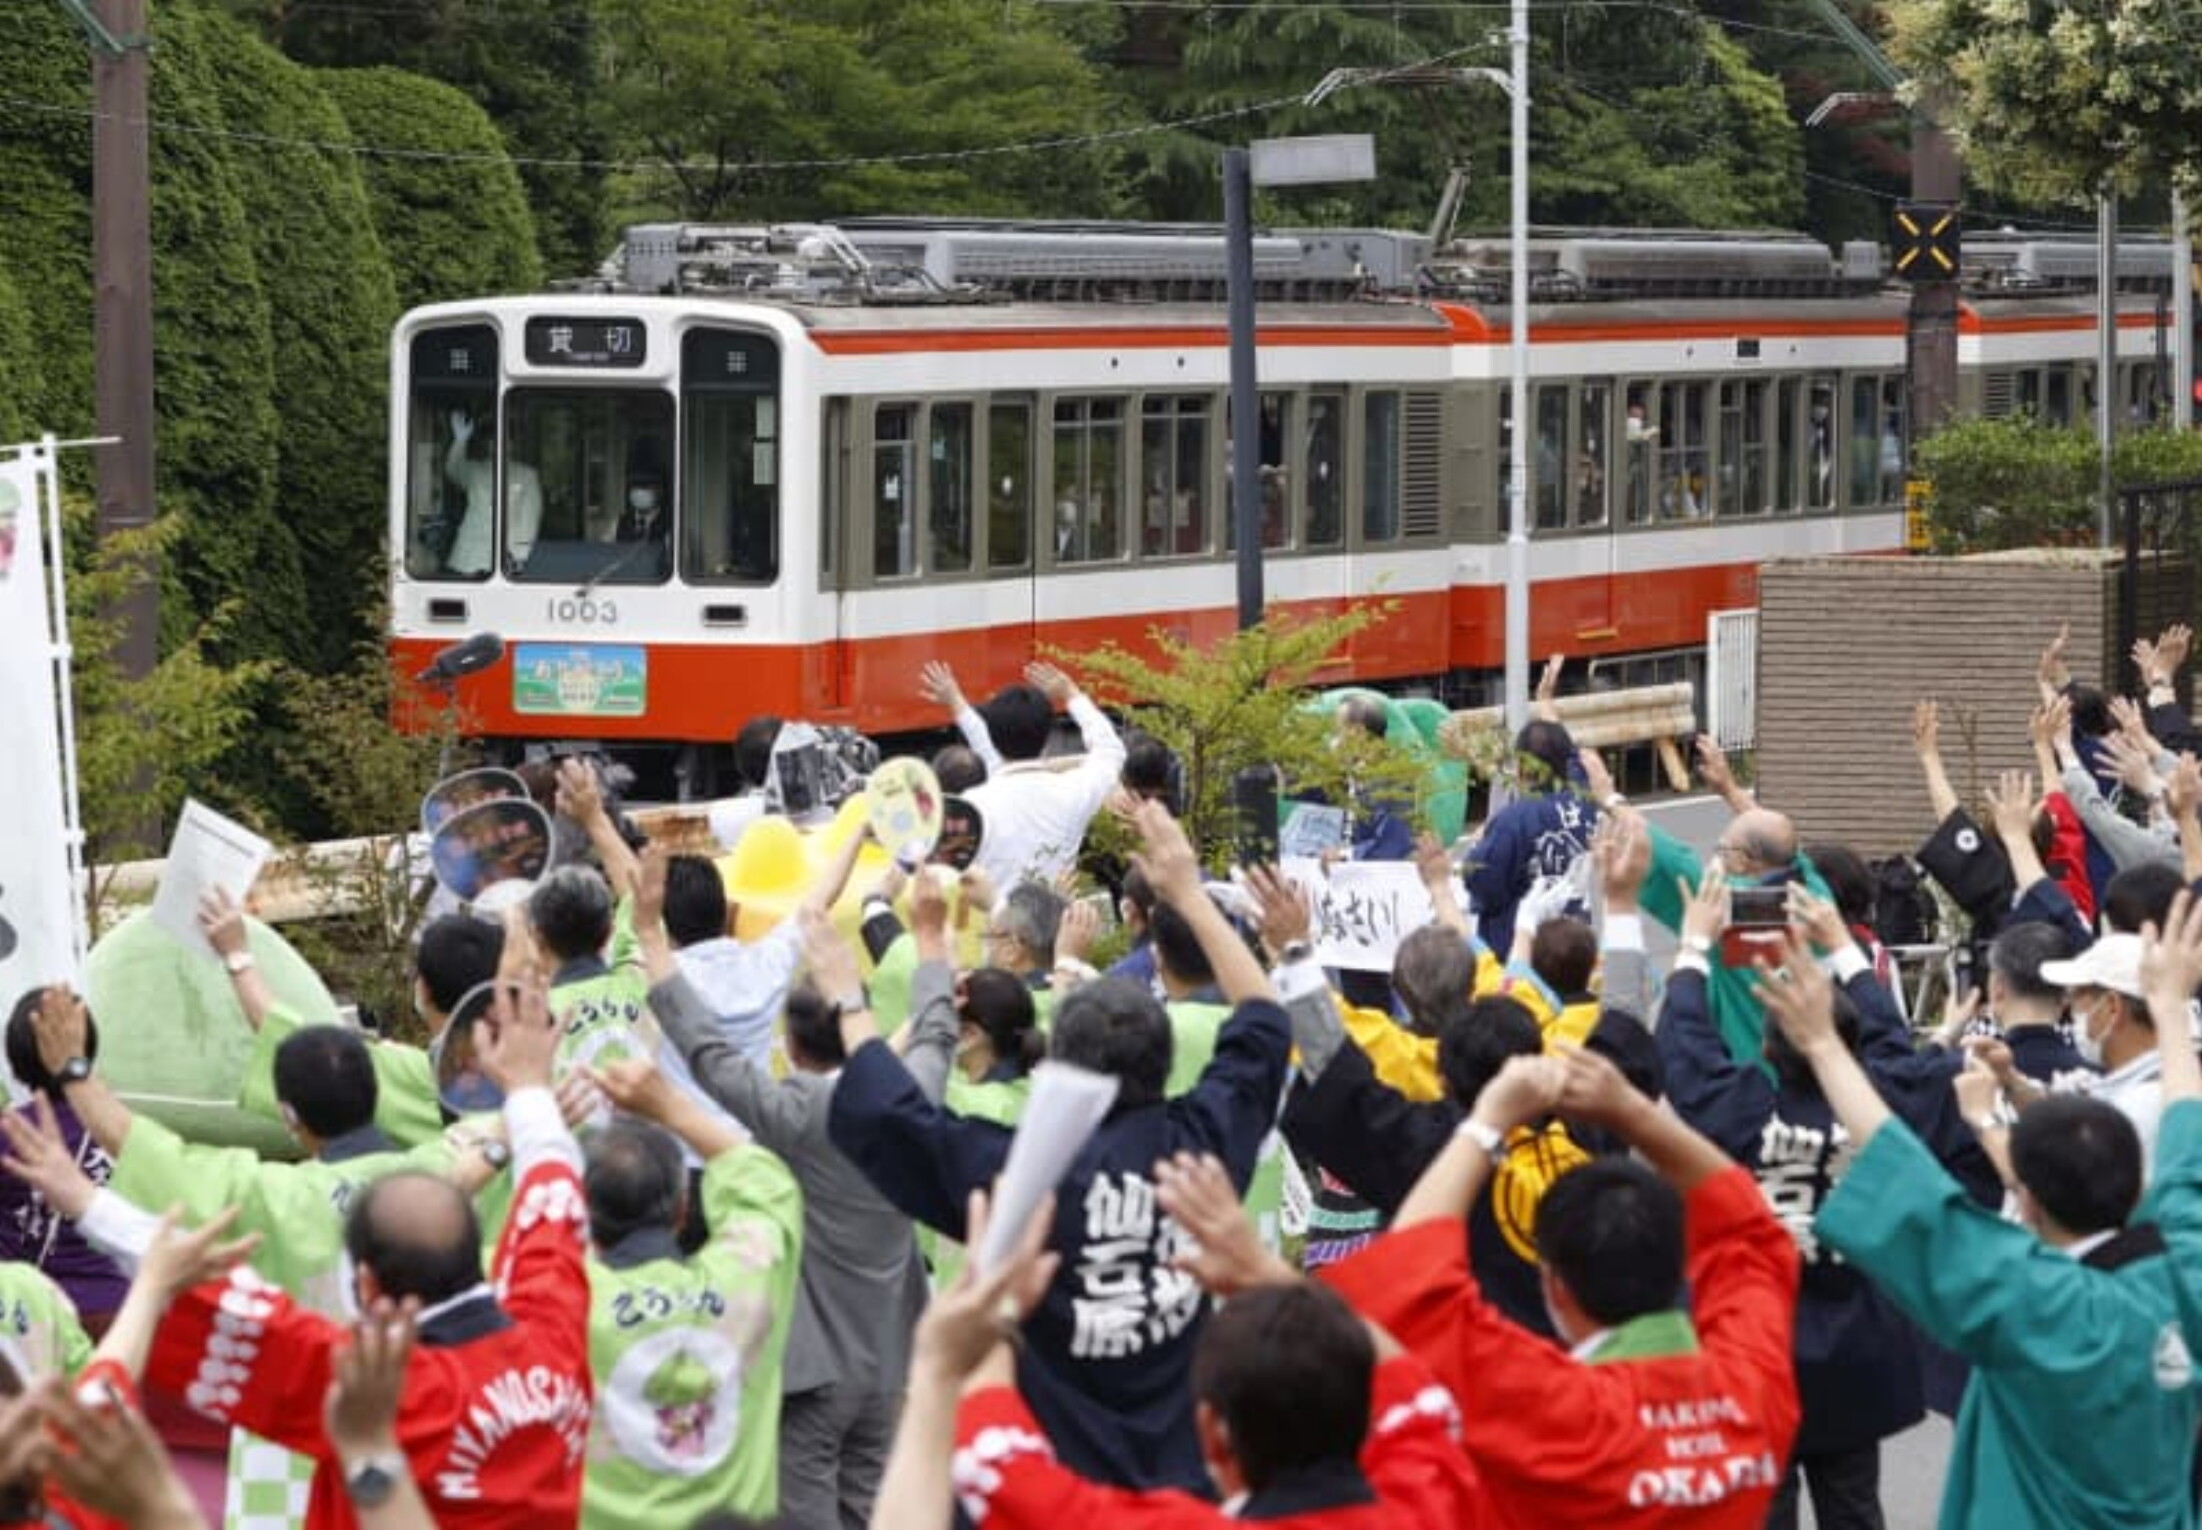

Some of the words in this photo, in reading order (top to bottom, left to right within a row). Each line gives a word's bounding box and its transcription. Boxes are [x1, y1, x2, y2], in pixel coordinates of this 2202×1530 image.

[547, 597, 618, 624] 1003
[1071, 1171, 1154, 1358] 仙石原
